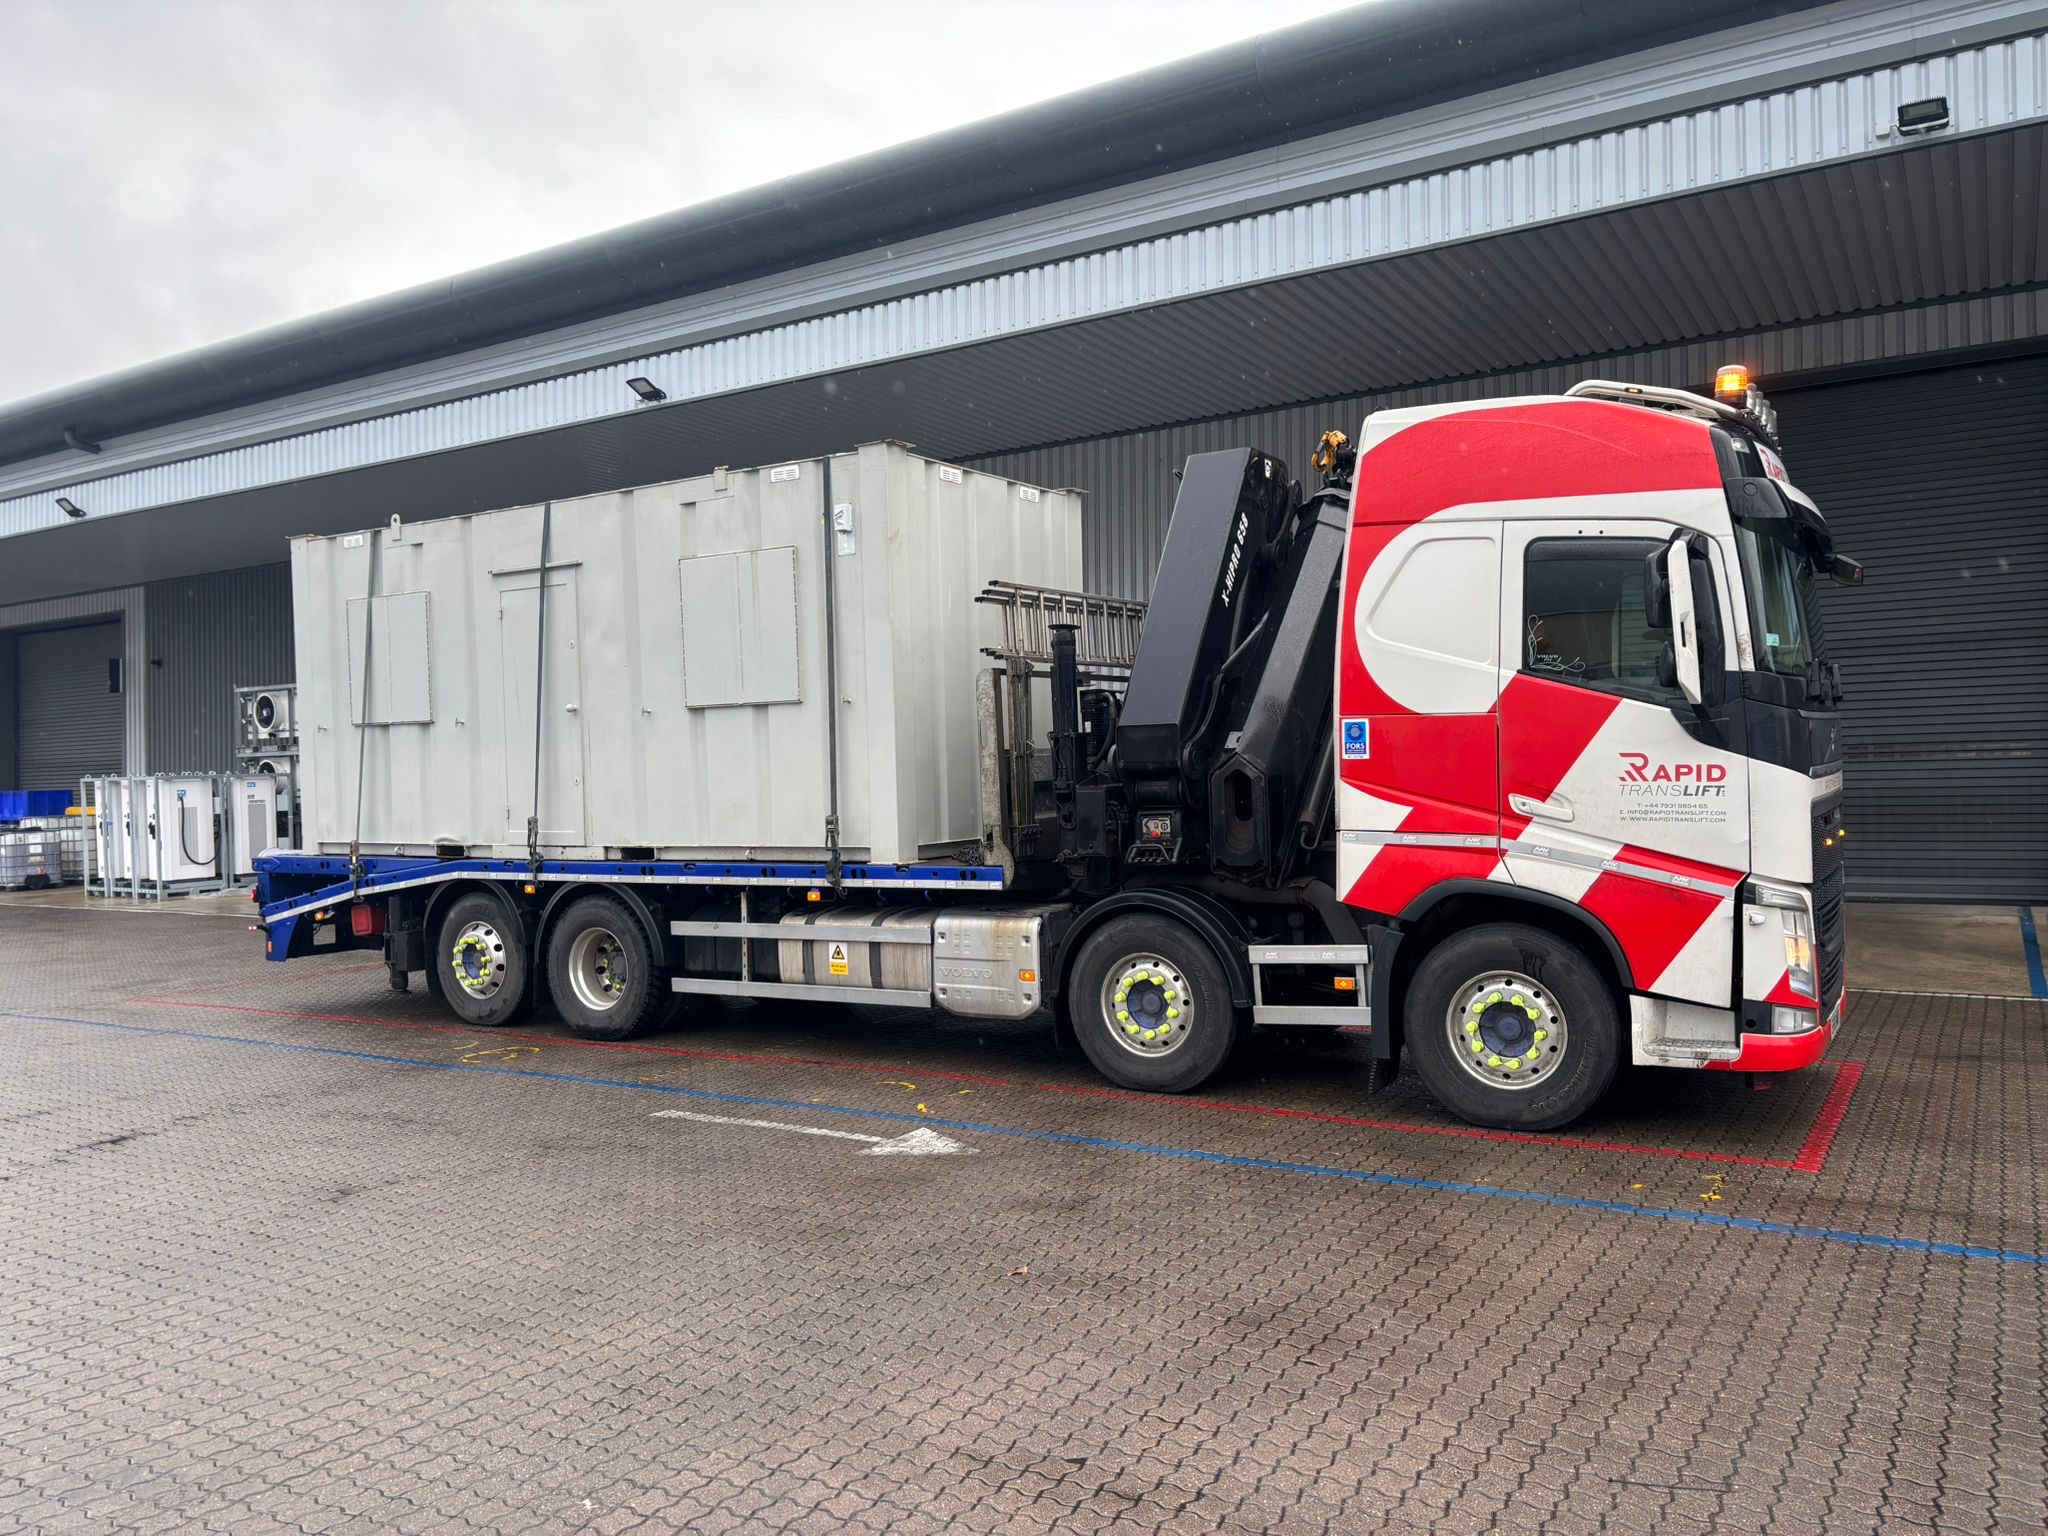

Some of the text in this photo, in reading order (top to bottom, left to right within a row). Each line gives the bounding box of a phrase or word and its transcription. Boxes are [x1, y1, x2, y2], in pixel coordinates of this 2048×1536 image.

[1221, 543, 1241, 608] X-HIPRO
[1346, 742, 1365, 750] FORS
[1618, 752, 1727, 783] RAPID
[1619, 784, 1726, 797] TRANSLIFT
[939, 966, 993, 980] VOLVO
